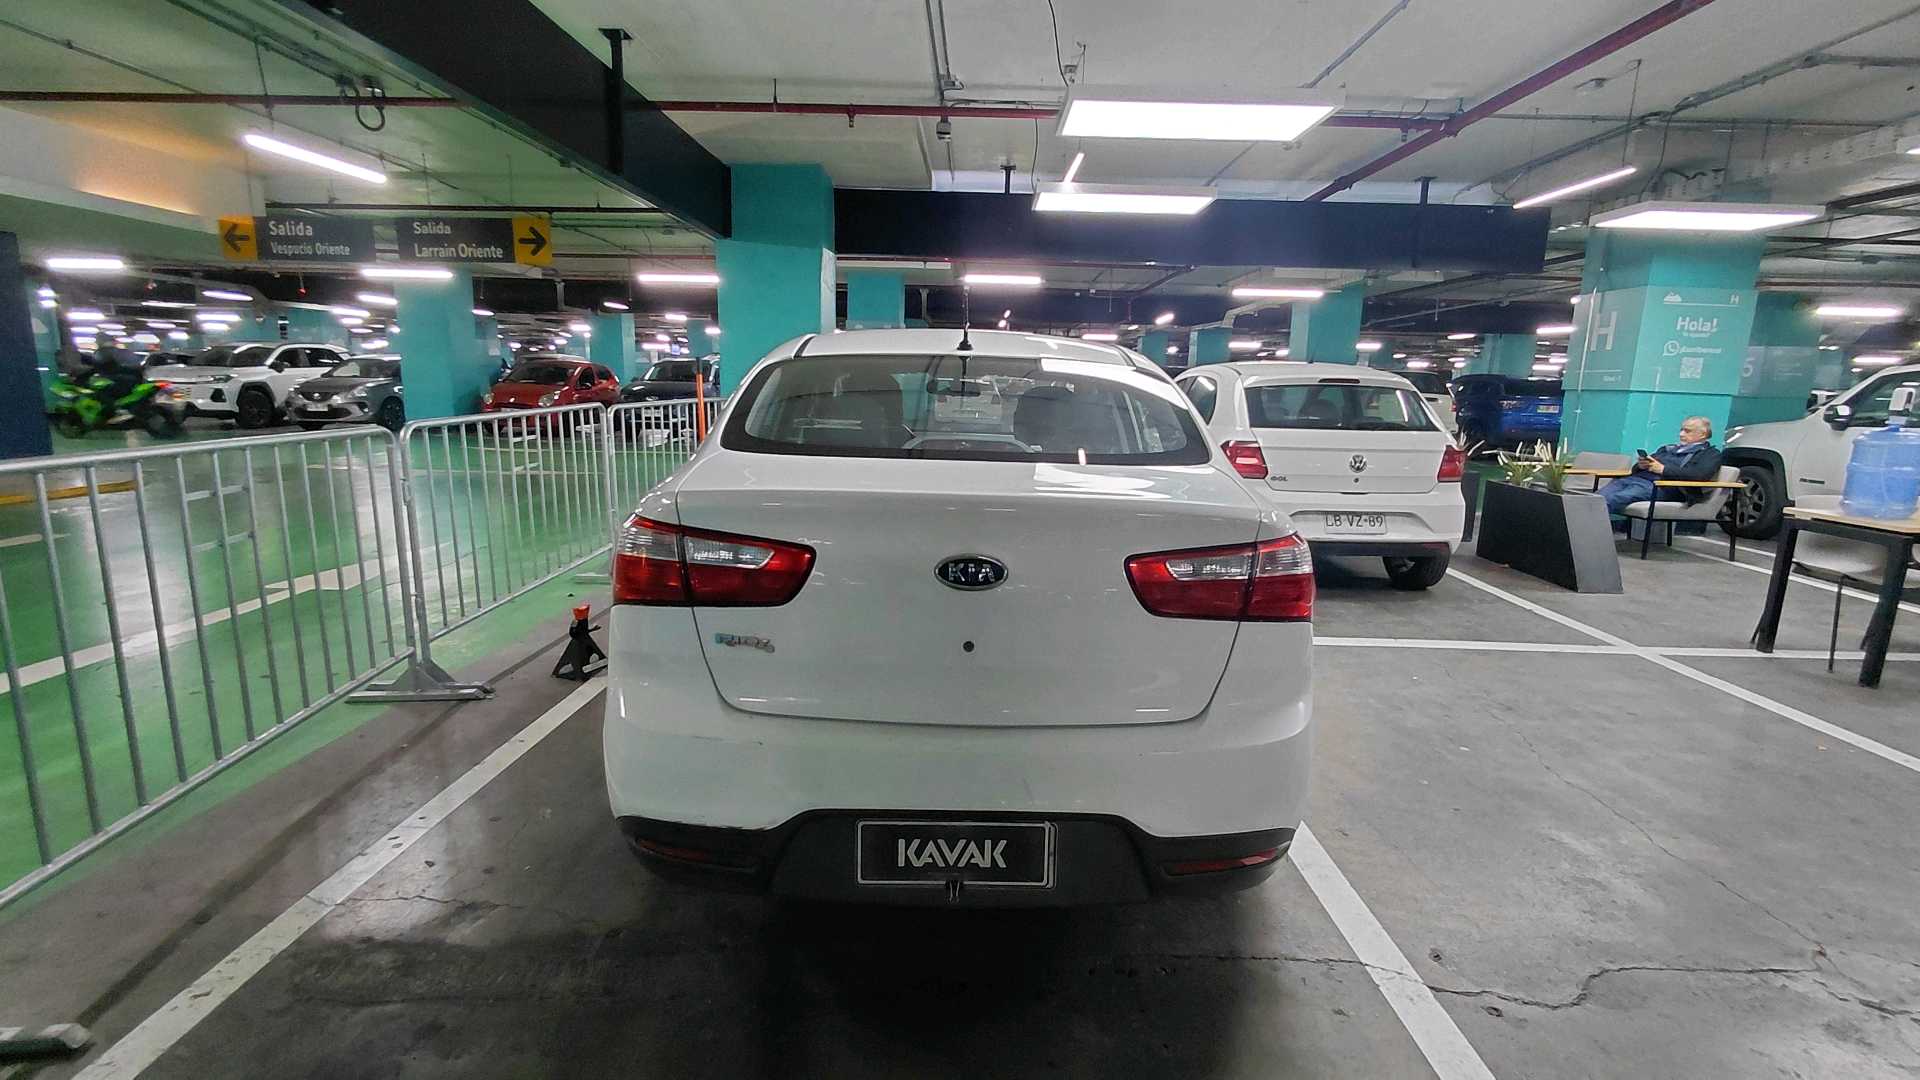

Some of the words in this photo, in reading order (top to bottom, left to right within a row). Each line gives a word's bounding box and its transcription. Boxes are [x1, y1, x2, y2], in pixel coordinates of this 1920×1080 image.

[268, 220, 313, 236] Salida
[413, 221, 452, 235] Salida
[270, 241, 313, 256] Vespucio
[315, 242, 351, 256] Oriente
[458, 243, 503, 258] Oriente
[1730, 294, 1740, 304] H
[1590, 311, 1617, 351] H
[1676, 316, 1718, 333] Hola!
[948, 563, 995, 582] KIA
[897, 838, 1007, 868] KAVAK
